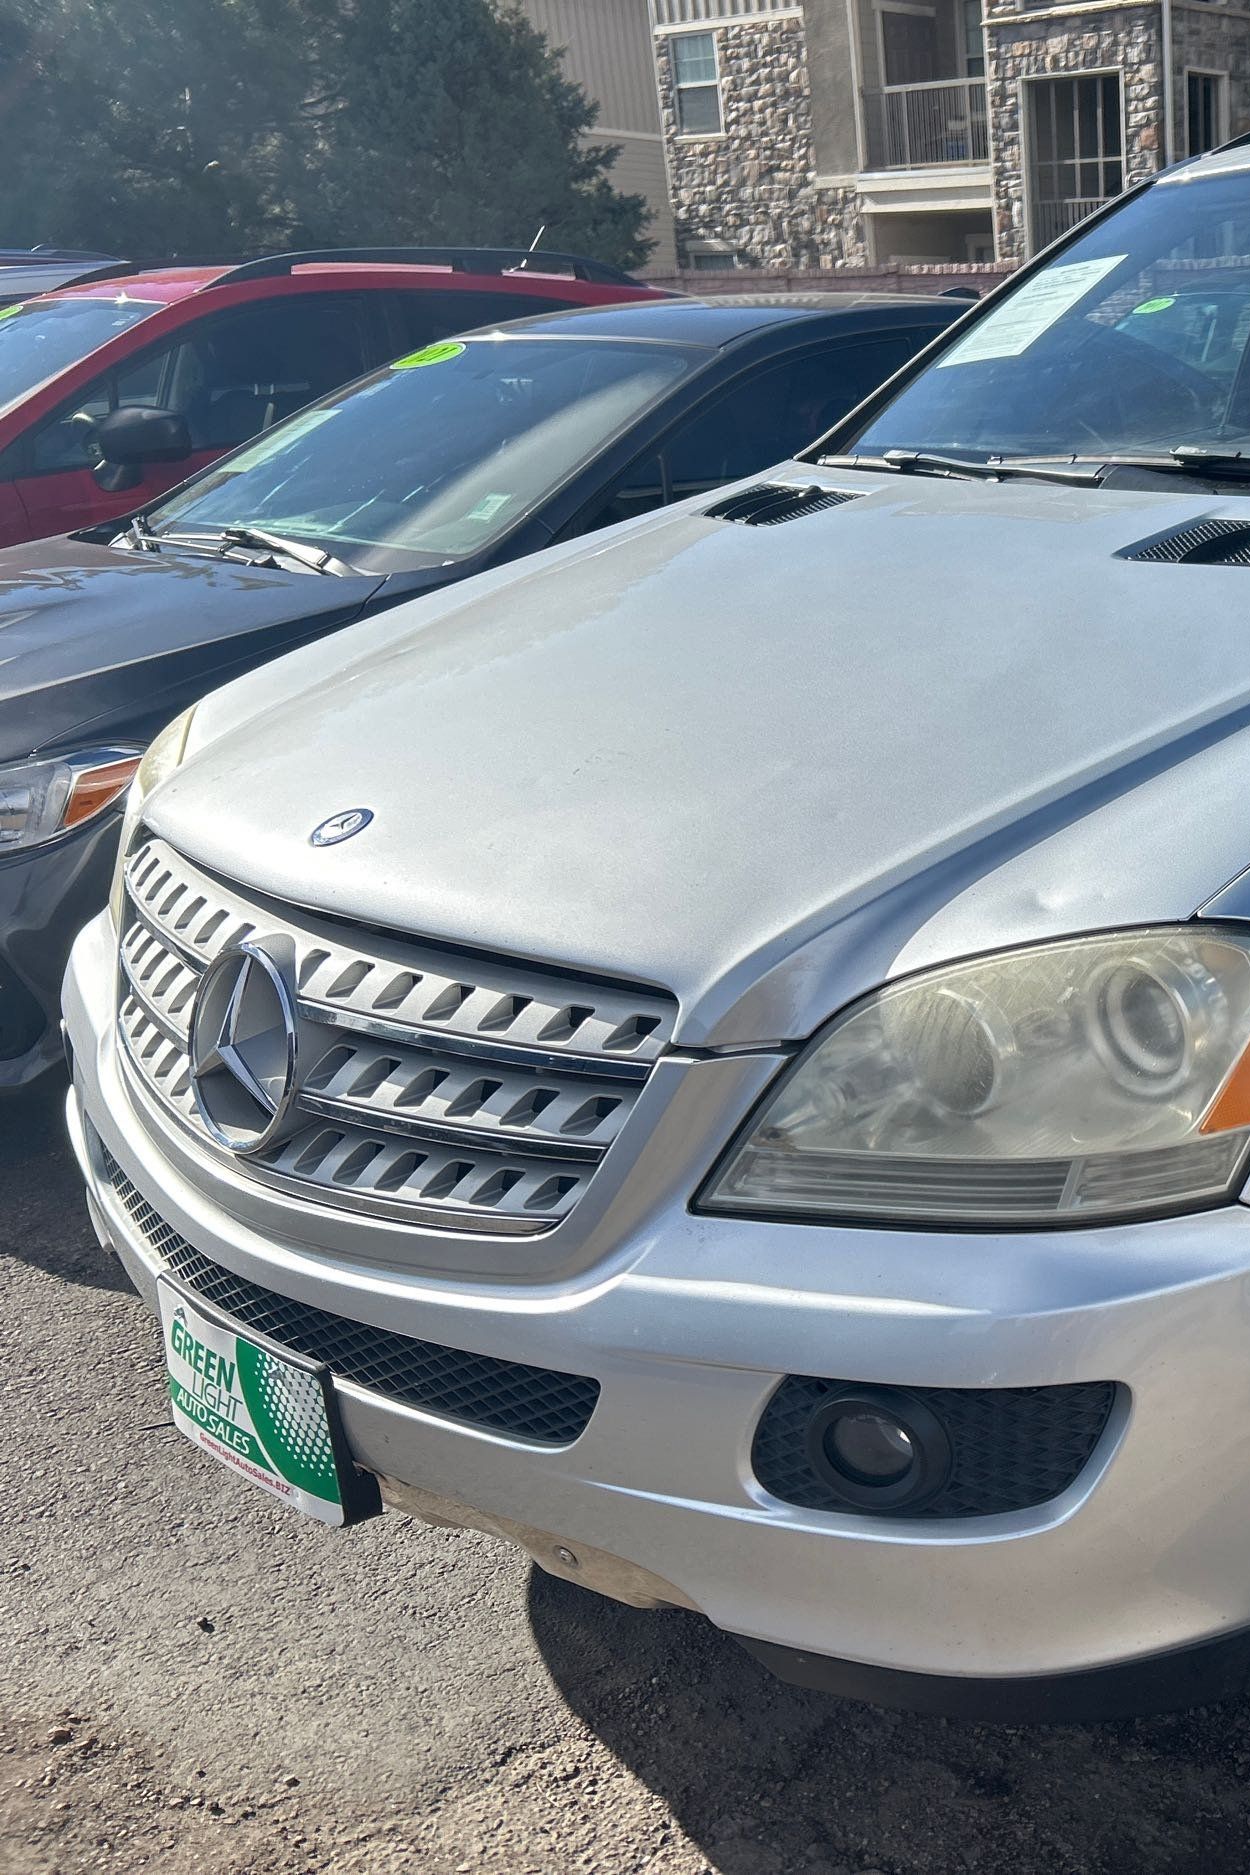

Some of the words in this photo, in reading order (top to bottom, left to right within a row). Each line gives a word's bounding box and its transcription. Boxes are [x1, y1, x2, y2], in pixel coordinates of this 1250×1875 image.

[171, 1319, 236, 1393] GREEN
[177, 1388, 208, 1422] AUTO
[206, 1415, 250, 1455] SALES
[192, 1371, 244, 1421] LIGHT
